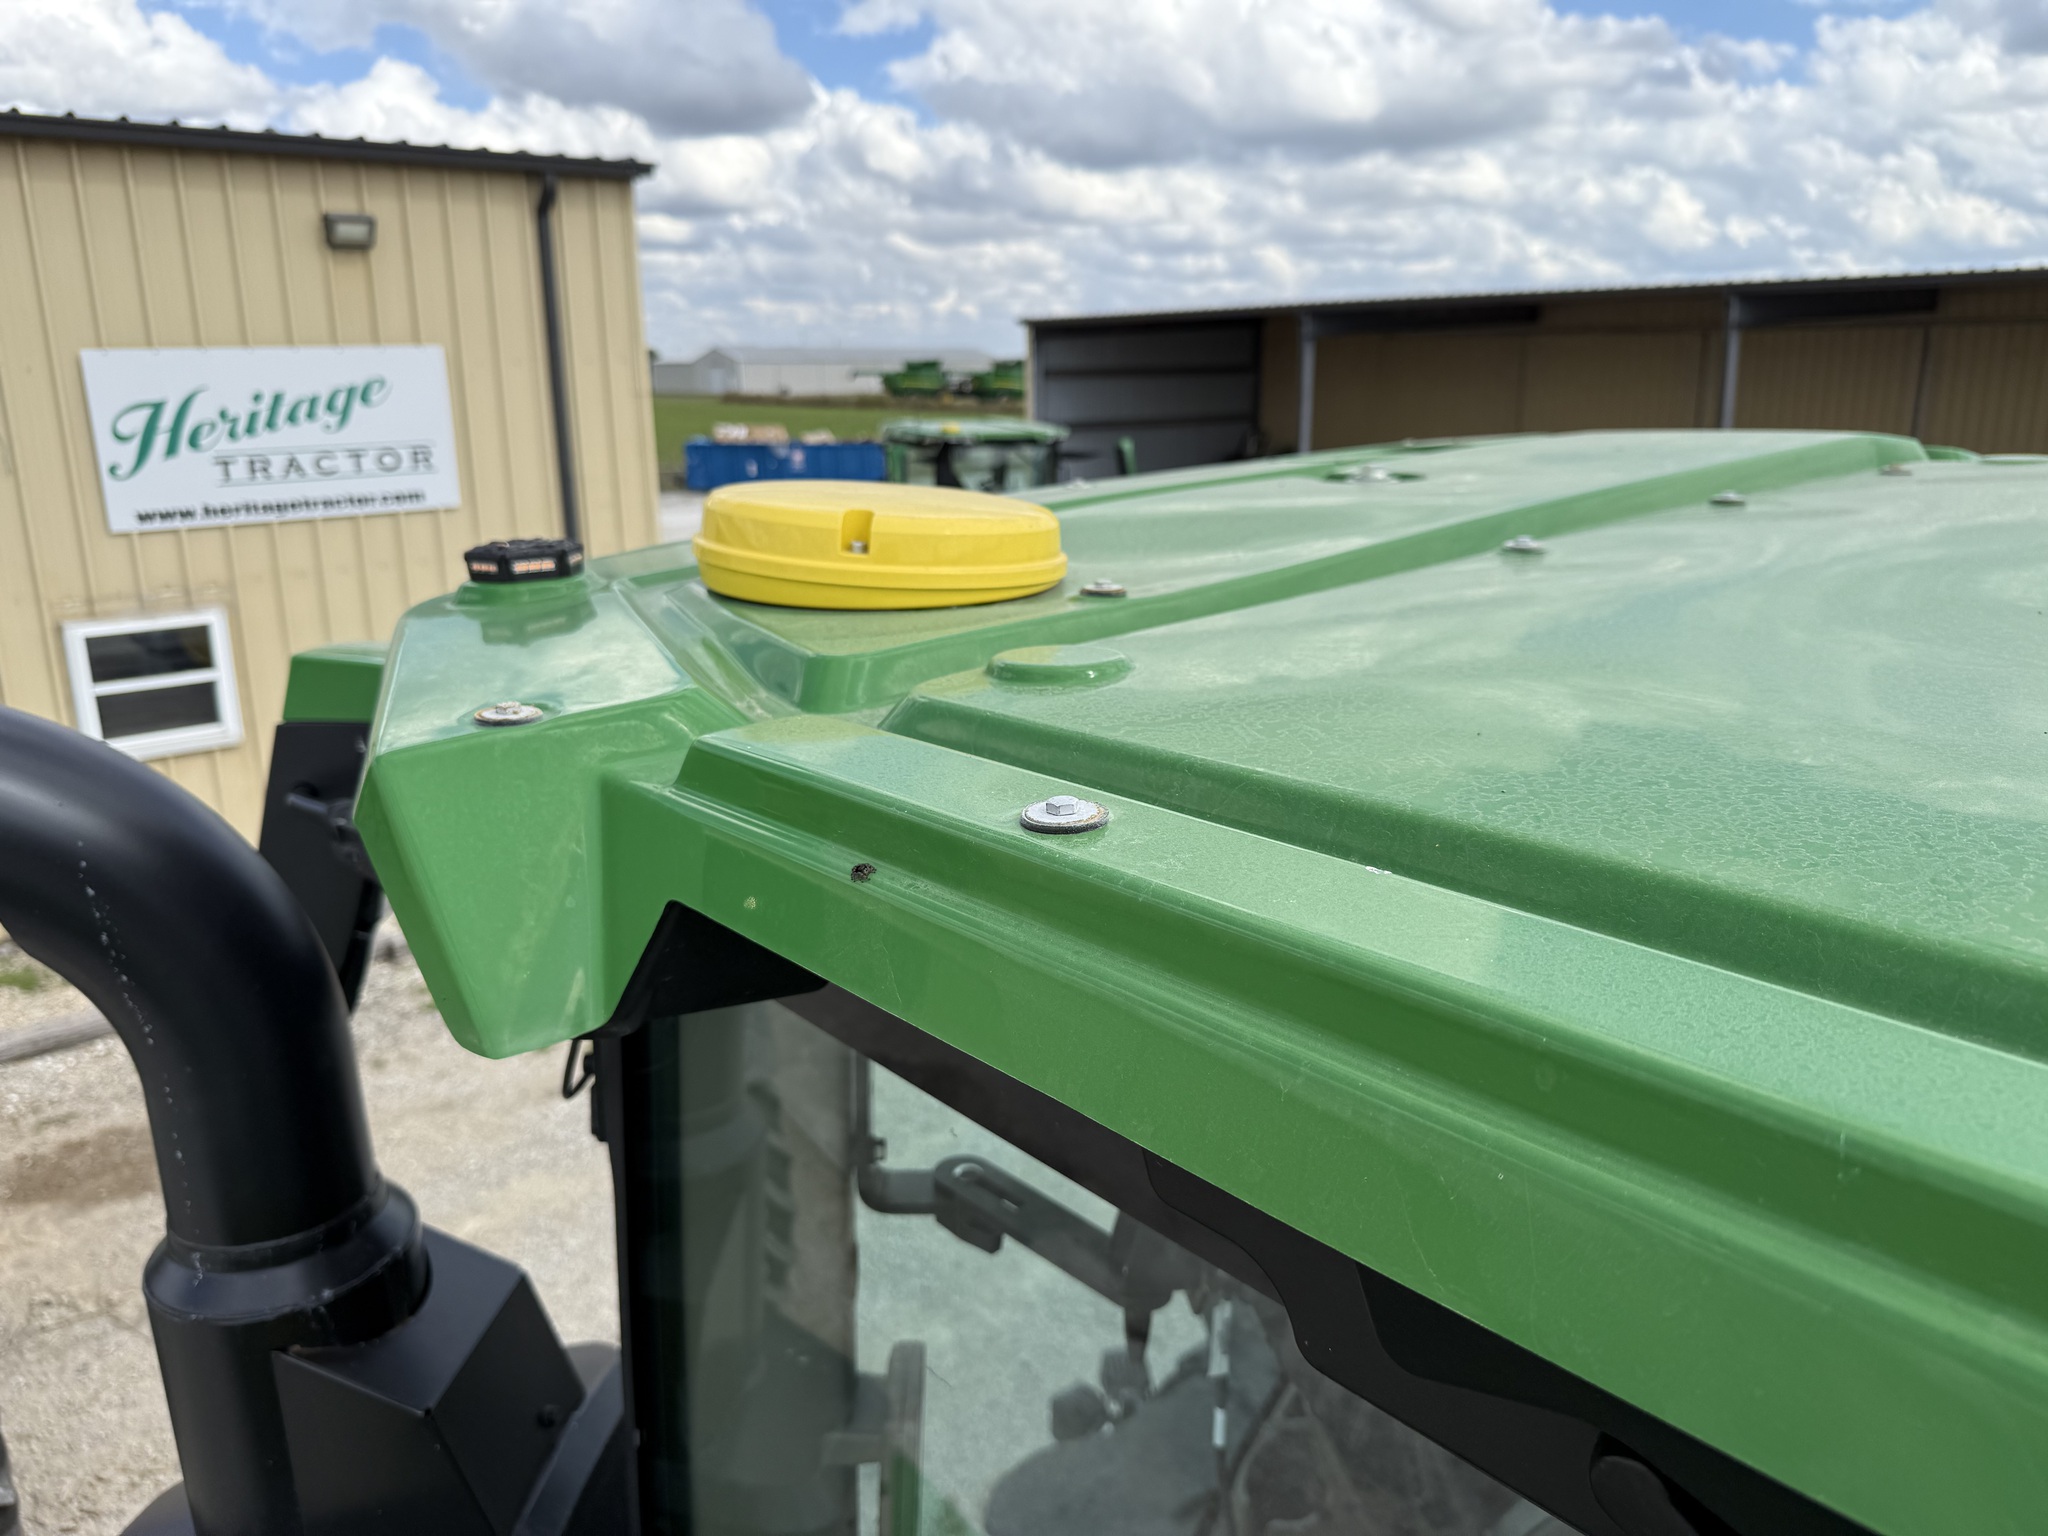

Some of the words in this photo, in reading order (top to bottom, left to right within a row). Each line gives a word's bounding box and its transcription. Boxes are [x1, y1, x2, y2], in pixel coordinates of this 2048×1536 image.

[109, 376, 388, 481] Heritage
[217, 446, 434, 482] TRACTOR
[136, 490, 426, 525] www.heritagetractor.com
